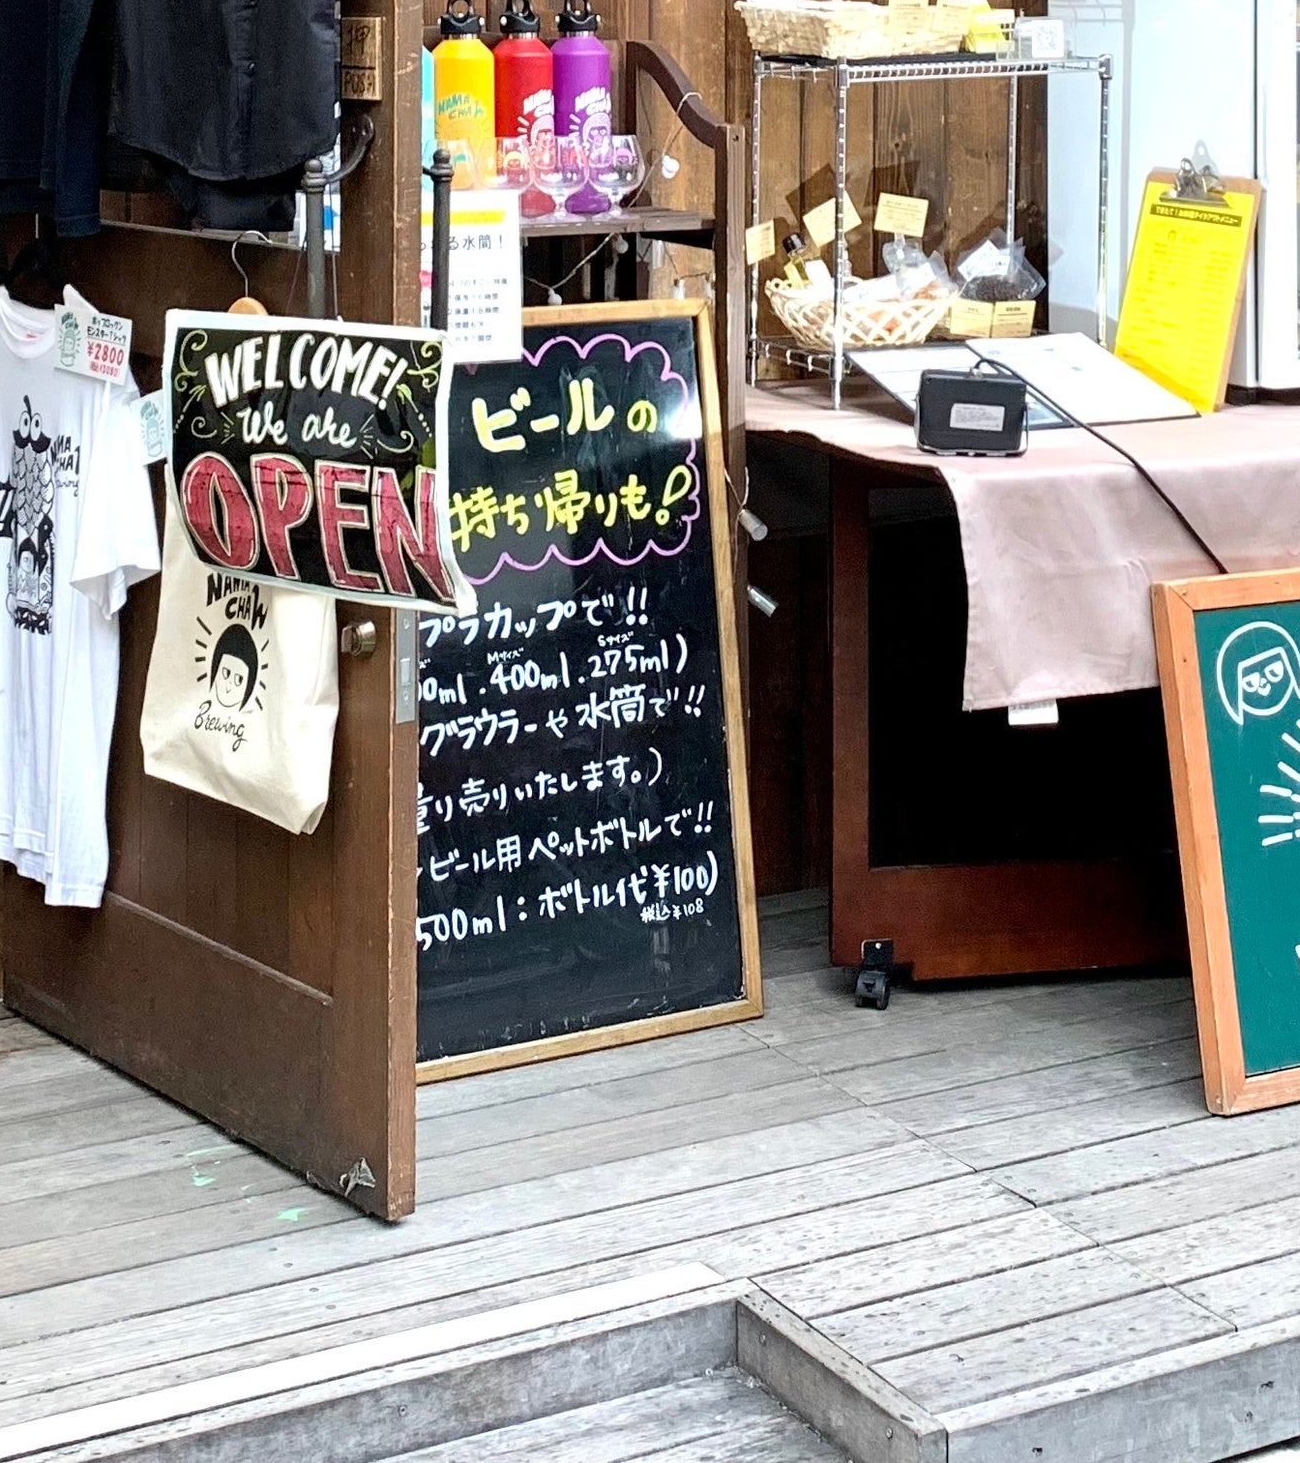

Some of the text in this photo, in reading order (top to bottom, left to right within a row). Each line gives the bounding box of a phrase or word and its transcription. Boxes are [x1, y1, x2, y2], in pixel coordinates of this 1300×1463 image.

[87, 340, 125, 367] ¥2800
[205, 331, 407, 410] WELCOME!
[238, 404, 358, 449] We are
[472, 377, 658, 454] ビールの
[181, 451, 458, 602] OPEN
[194, 699, 248, 752] Brewing
